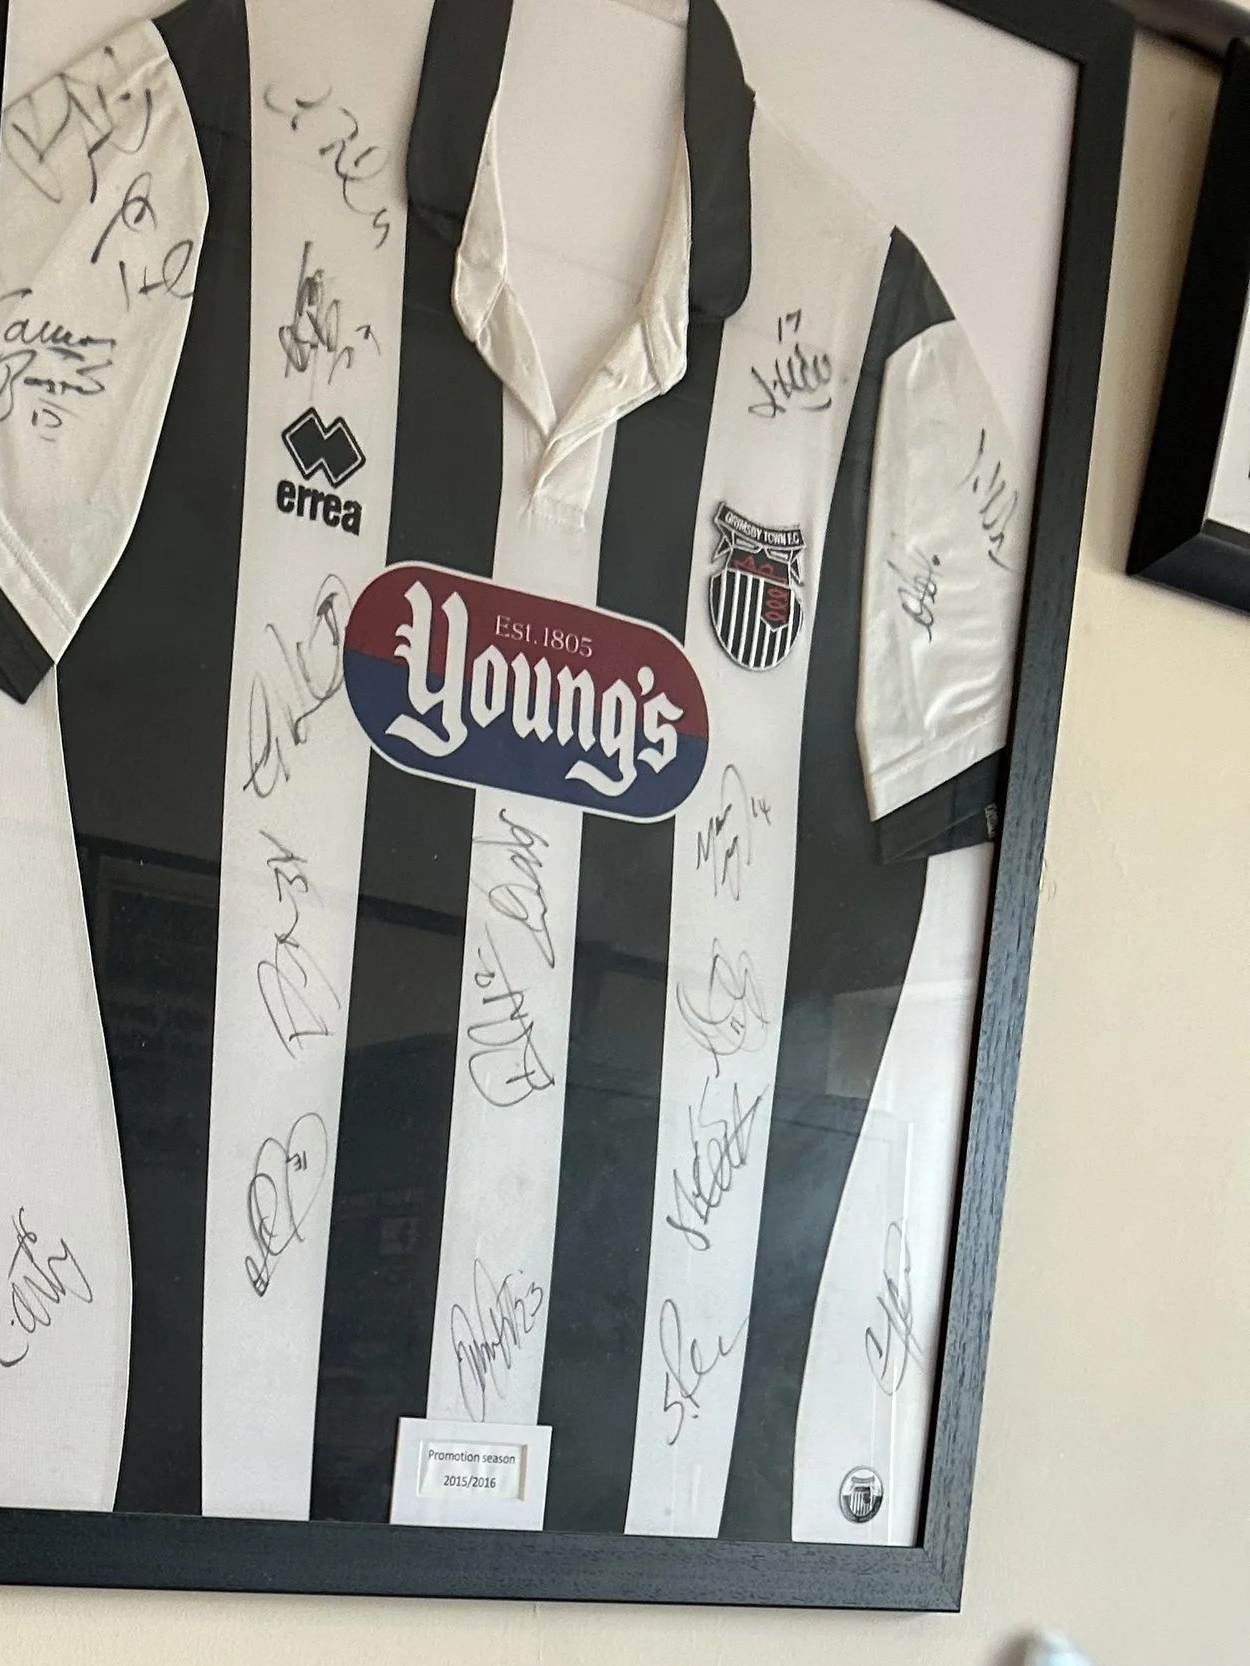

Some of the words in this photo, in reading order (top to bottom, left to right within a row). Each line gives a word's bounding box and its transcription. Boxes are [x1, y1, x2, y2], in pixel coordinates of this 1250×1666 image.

[276, 479, 363, 536] errea
[725, 510, 762, 540] GRIMSBY
[762, 531, 786, 546] TOWN
[385, 580, 684, 797] Young's
[428, 1449, 480, 1463] Promotion
[482, 1454, 515, 1464] season
[443, 1475, 496, 1488] 2015/2016
